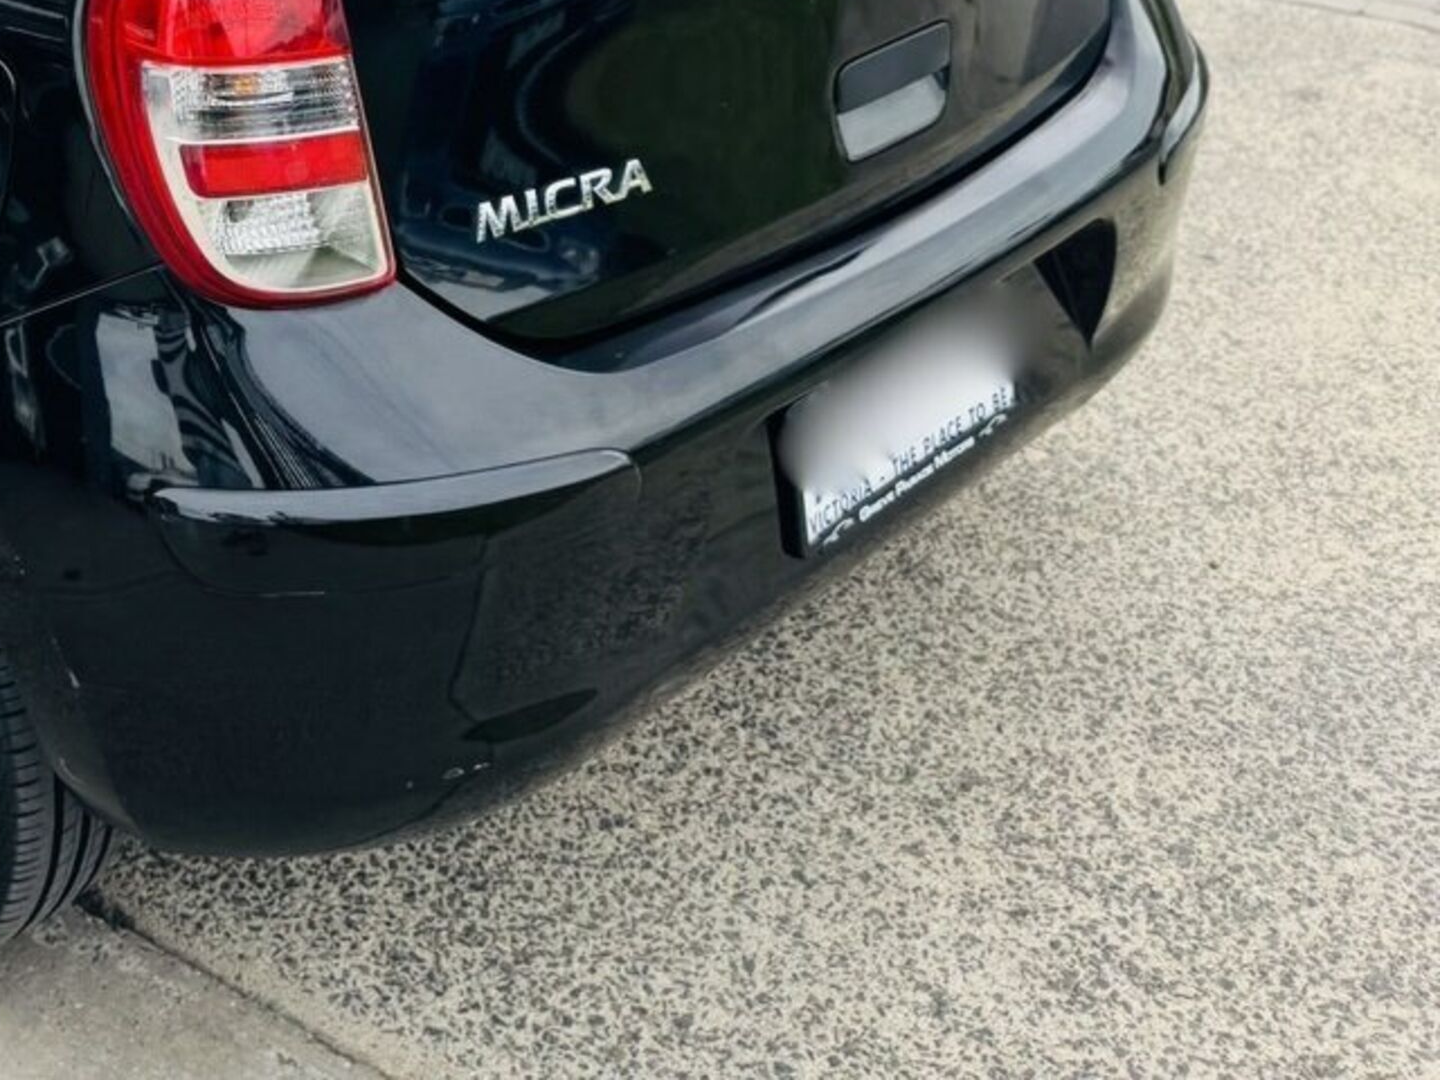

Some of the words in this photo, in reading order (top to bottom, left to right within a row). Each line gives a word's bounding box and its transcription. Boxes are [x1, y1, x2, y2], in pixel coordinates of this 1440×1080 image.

[476, 158, 653, 244] MICRA
[890, 445, 917, 476] THE
[922, 415, 963, 454] PLACE
[968, 401, 987, 426] TO
[992, 386, 1007, 414] BE
